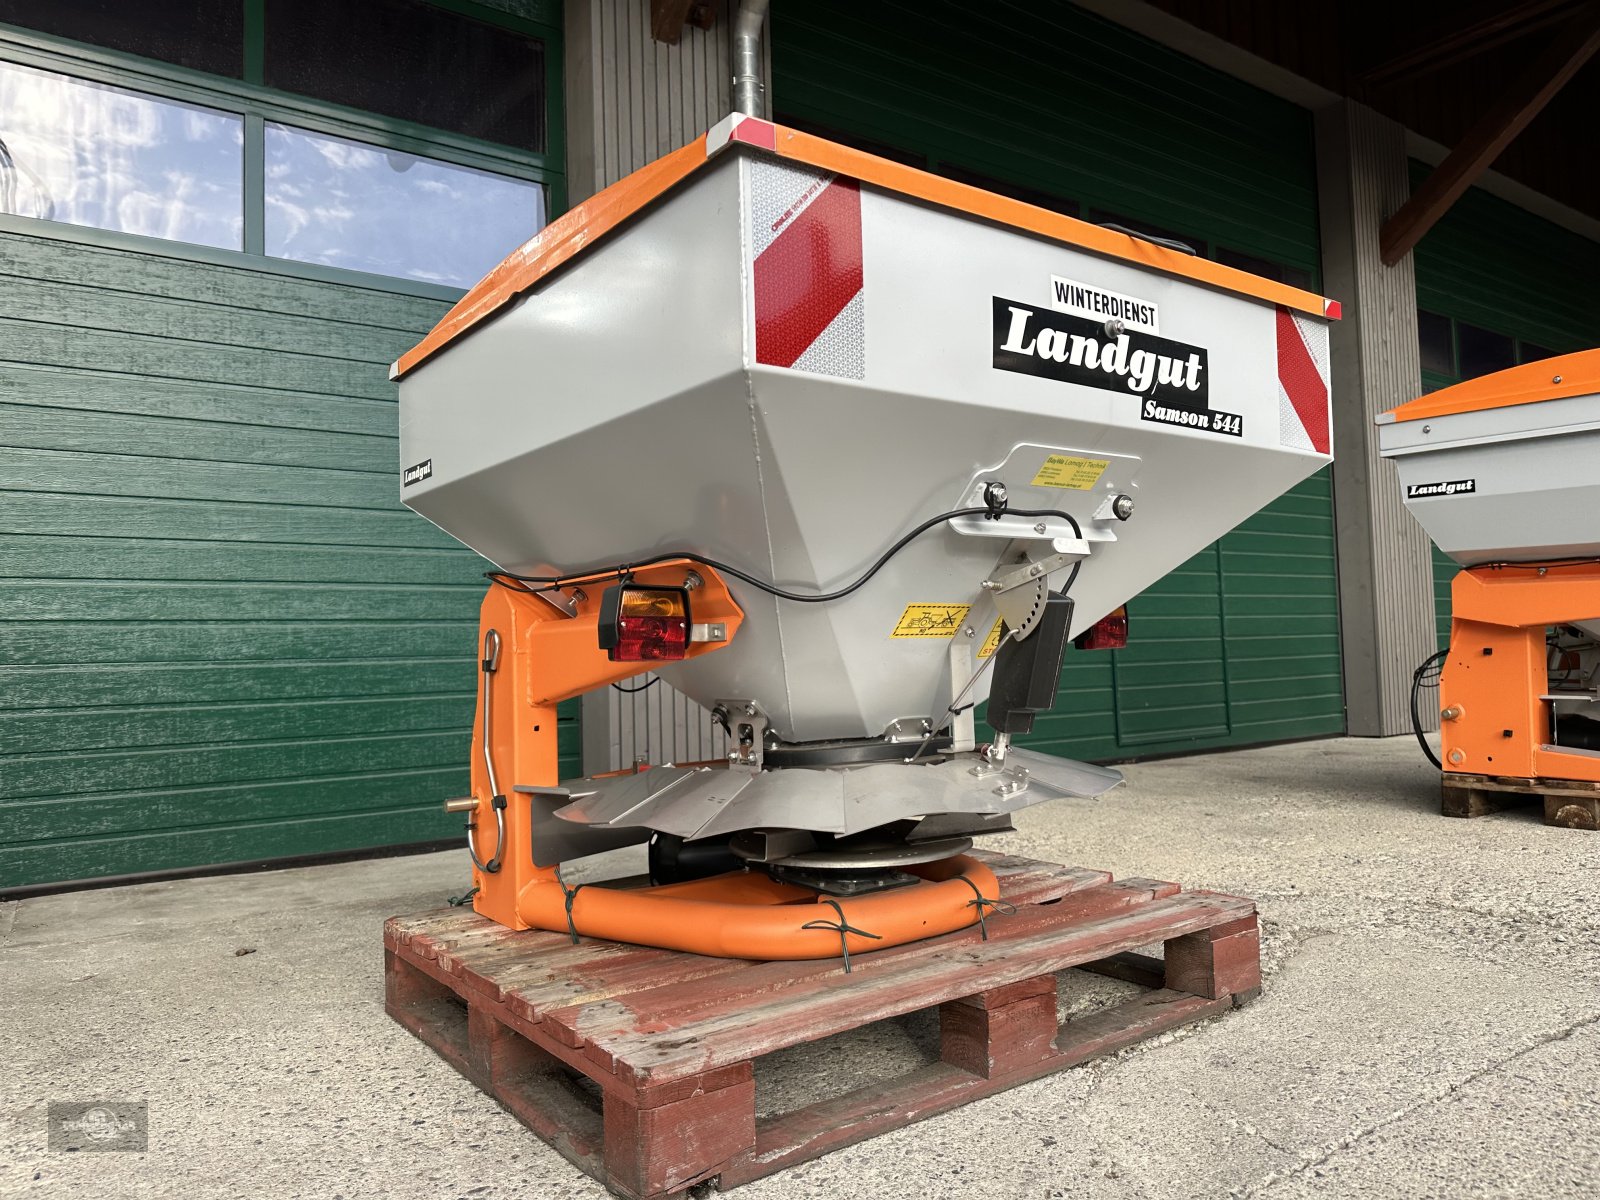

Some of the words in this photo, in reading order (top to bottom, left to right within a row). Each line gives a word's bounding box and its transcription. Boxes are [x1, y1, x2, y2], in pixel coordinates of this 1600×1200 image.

[1054, 281, 1155, 326] WINTERDIENST
[1000, 306, 1203, 394] Landgut
[1143, 400, 1210, 428] Samson
[1212, 412, 1241, 434] 544
[404, 461, 431, 483] Landgut
[1409, 480, 1473, 495] Landgut
